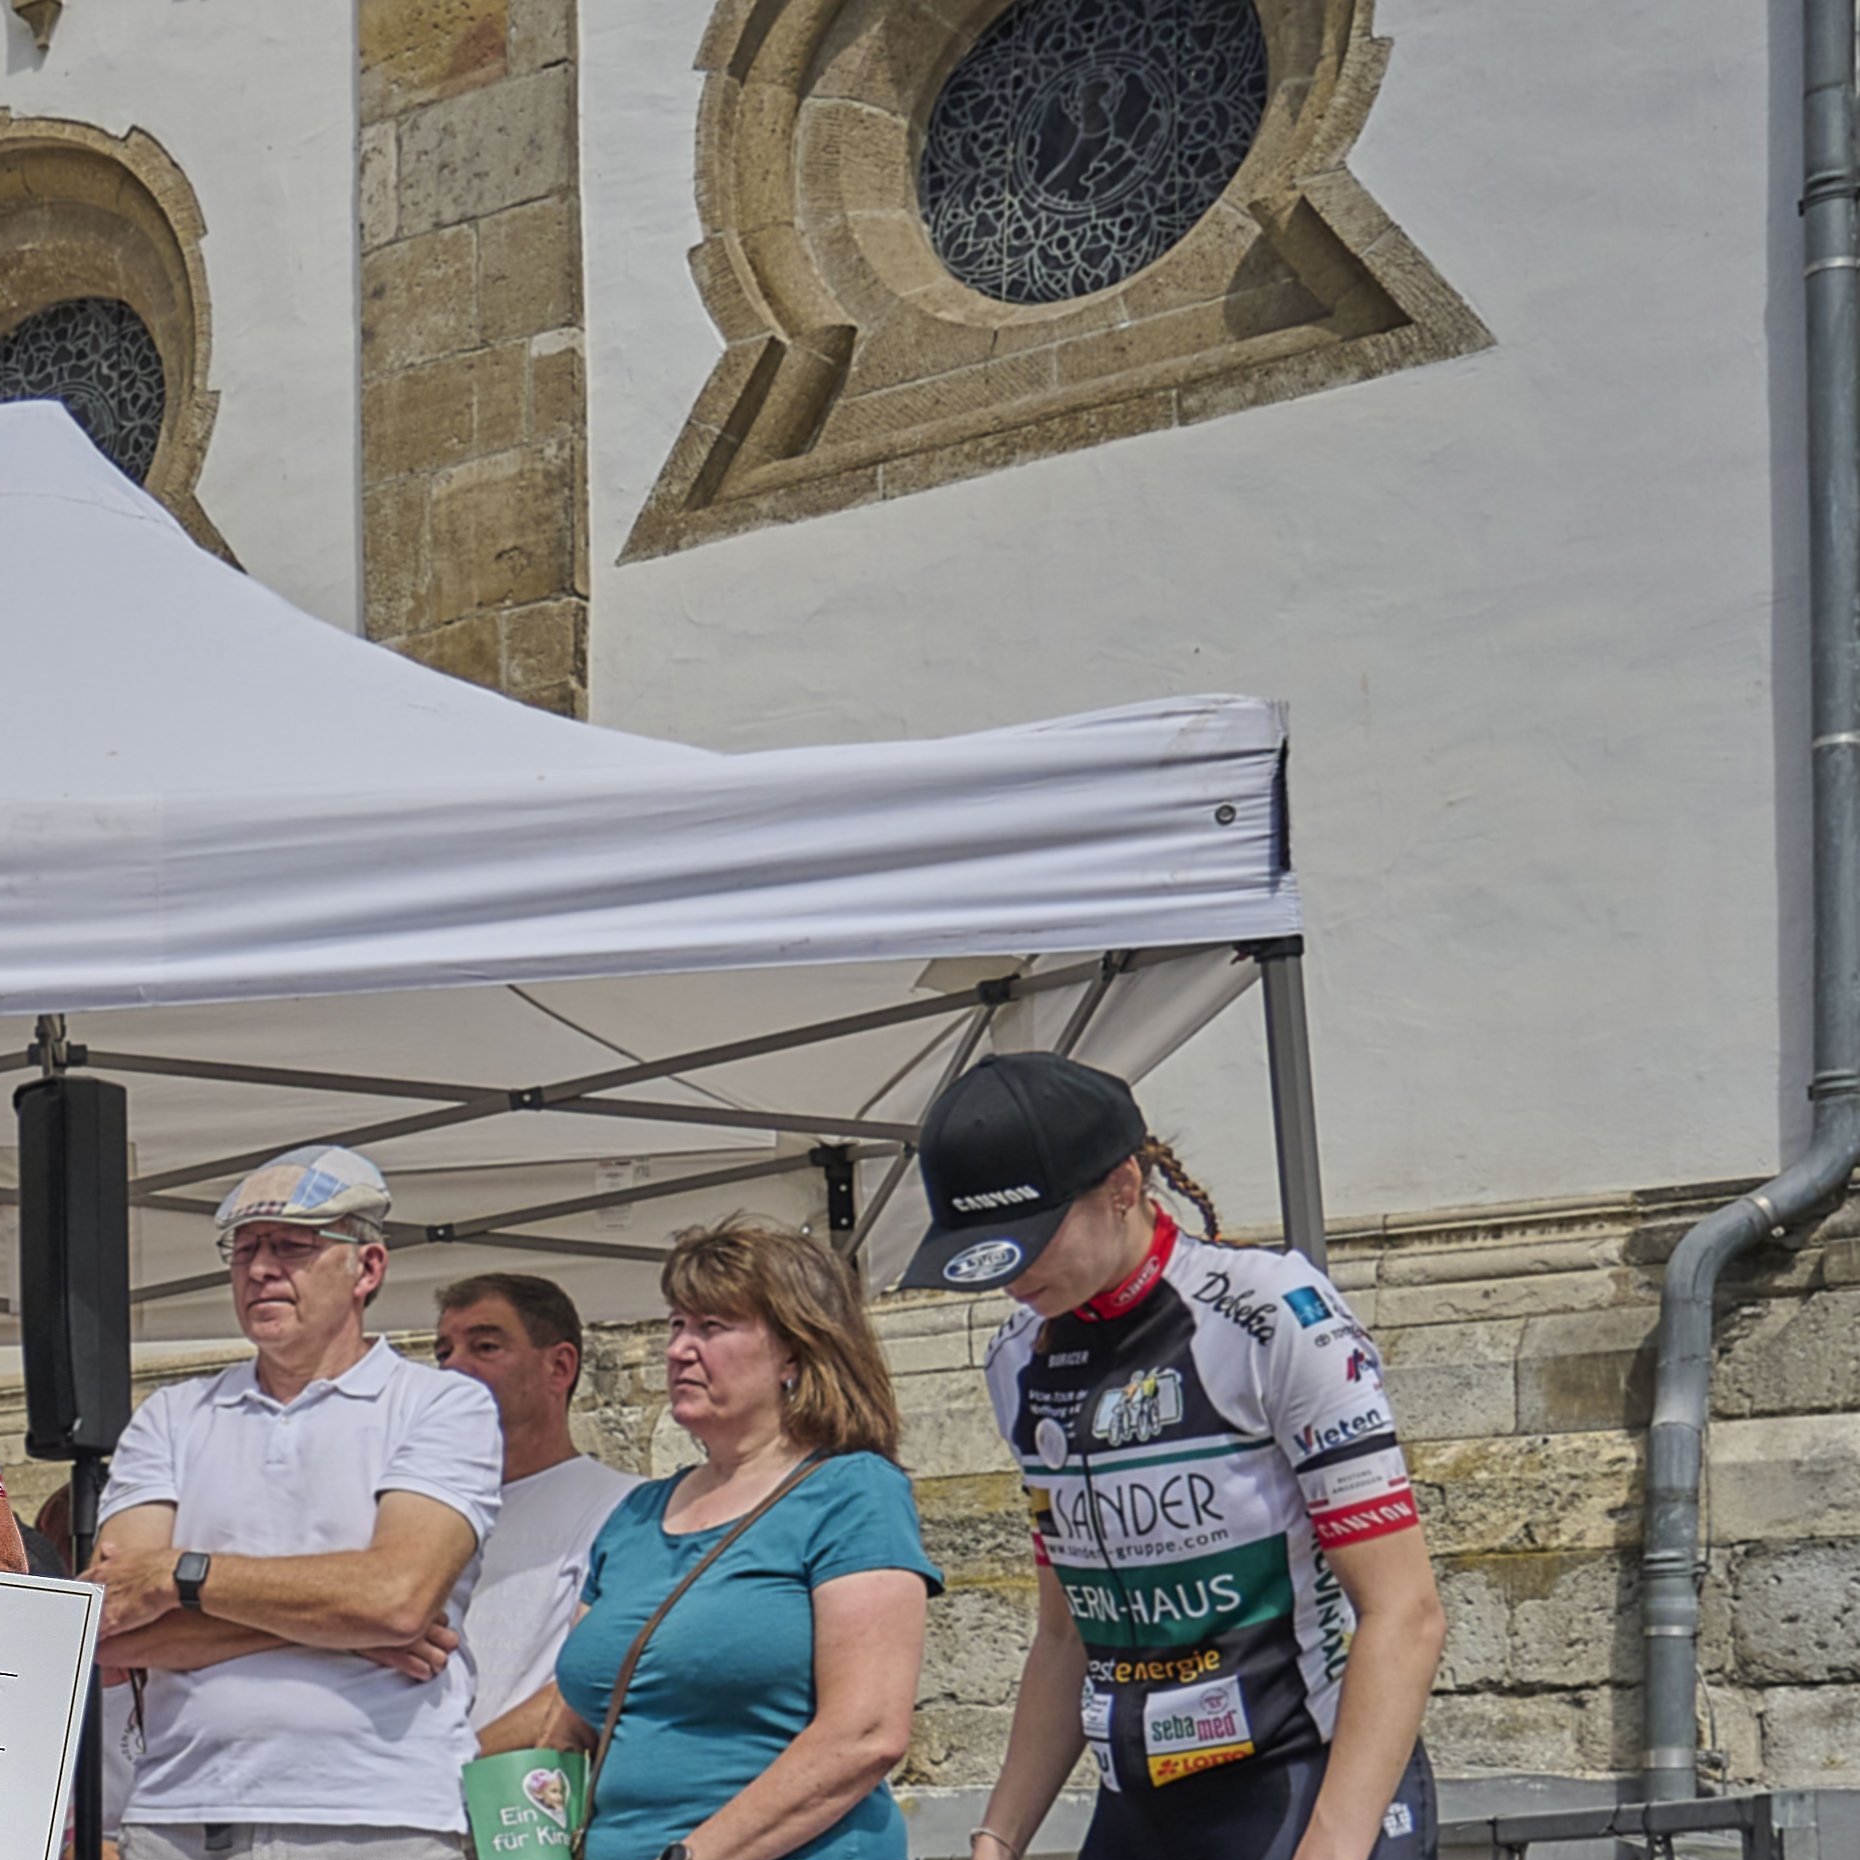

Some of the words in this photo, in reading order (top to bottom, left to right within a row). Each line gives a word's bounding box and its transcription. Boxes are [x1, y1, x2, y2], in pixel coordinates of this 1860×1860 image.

[952, 1184, 1040, 1211] CANYON
[1192, 1271, 1276, 1346] Debeka
[1293, 1408, 1381, 1456] Vieten
[1056, 1473, 1224, 1542] SANDER
[1317, 1500, 1414, 1540] CANYON
[1151, 1712, 1238, 1742] sebamed
[500, 1806, 539, 1827] Ein
[492, 1832, 530, 1852] für
